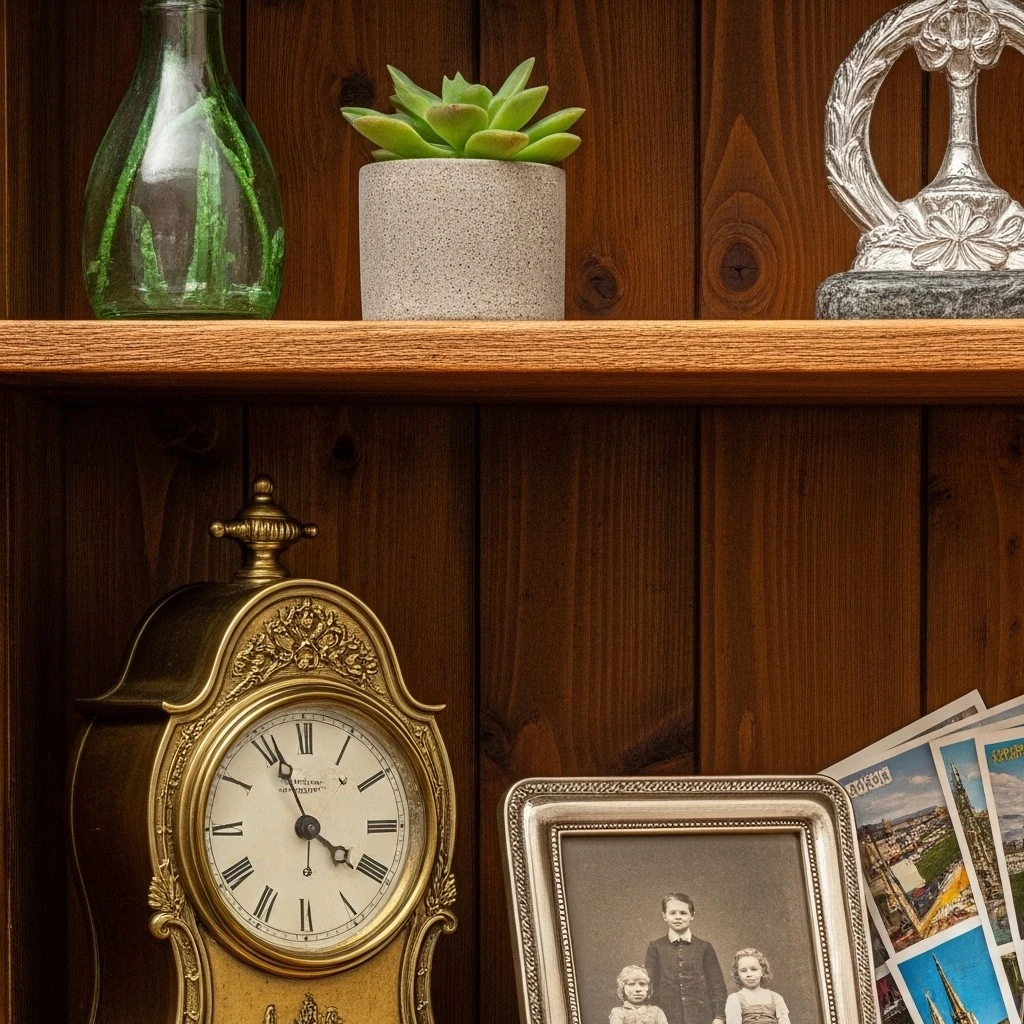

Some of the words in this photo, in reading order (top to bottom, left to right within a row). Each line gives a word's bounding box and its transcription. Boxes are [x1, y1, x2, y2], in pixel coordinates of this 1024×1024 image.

[335, 735, 352, 766] I
[356, 770, 386, 794] II
[366, 819, 398, 835] III
[355, 853, 389, 886] IIII
[298, 898, 315, 933] VI
